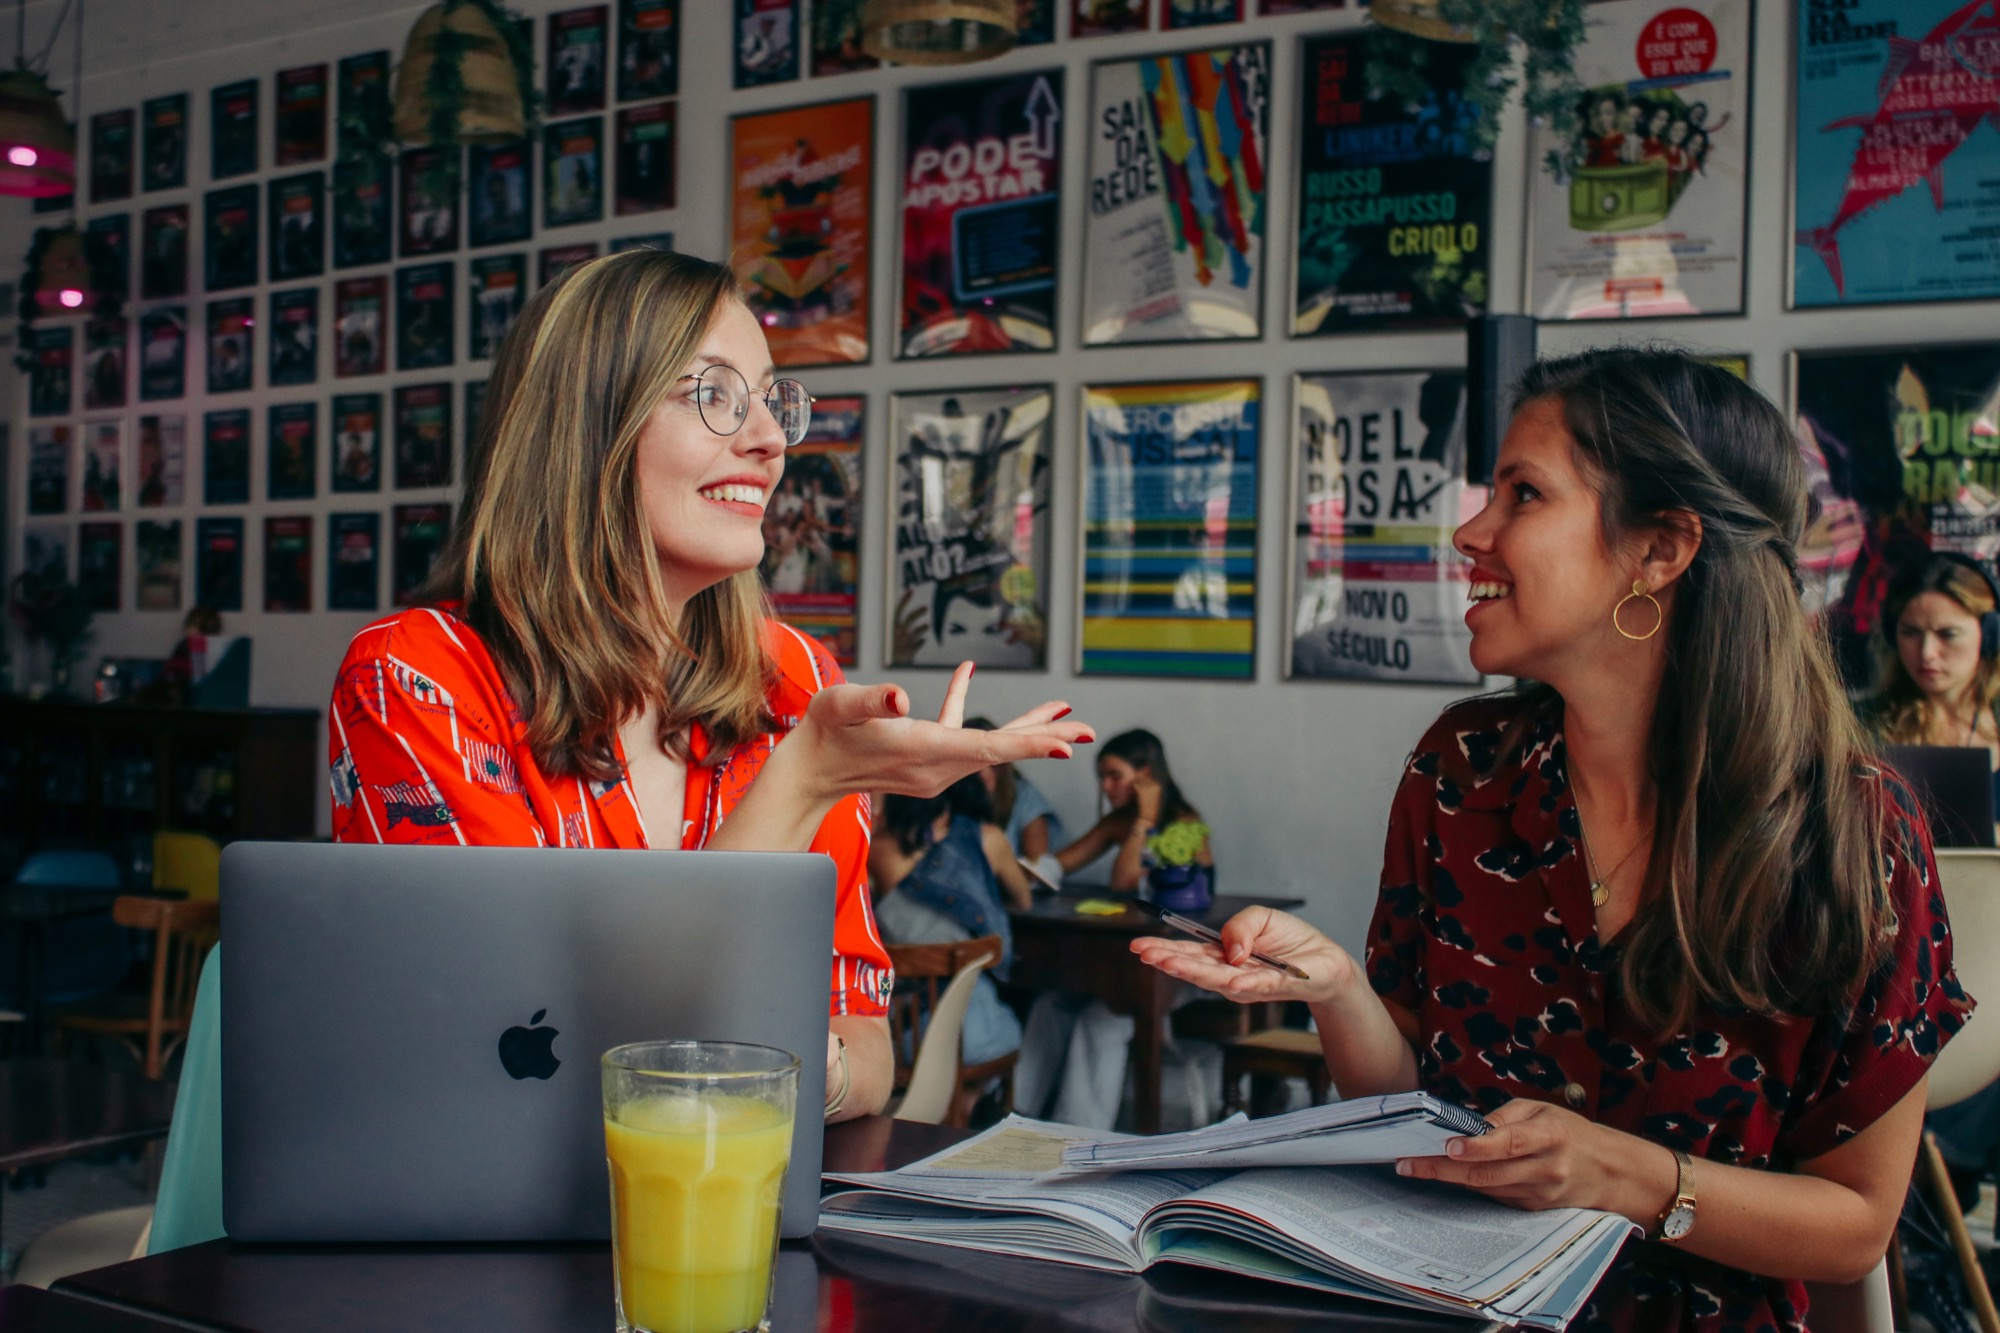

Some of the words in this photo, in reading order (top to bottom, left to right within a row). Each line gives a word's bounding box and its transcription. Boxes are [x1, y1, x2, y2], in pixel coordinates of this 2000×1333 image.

[1102, 98, 1145, 140] SAI
[911, 132, 1039, 184] PODE
[1115, 128, 1150, 168] DA
[903, 169, 1045, 210] APOSTAR
[1091, 158, 1158, 216] REDE
[1306, 167, 1382, 198] RUSSO
[1306, 191, 1456, 229] PASSAPUSSO
[1388, 222, 1479, 257] CRIOLO
[1307, 408, 1414, 465] NOEL
[1327, 628, 1411, 671] SÉCULO
